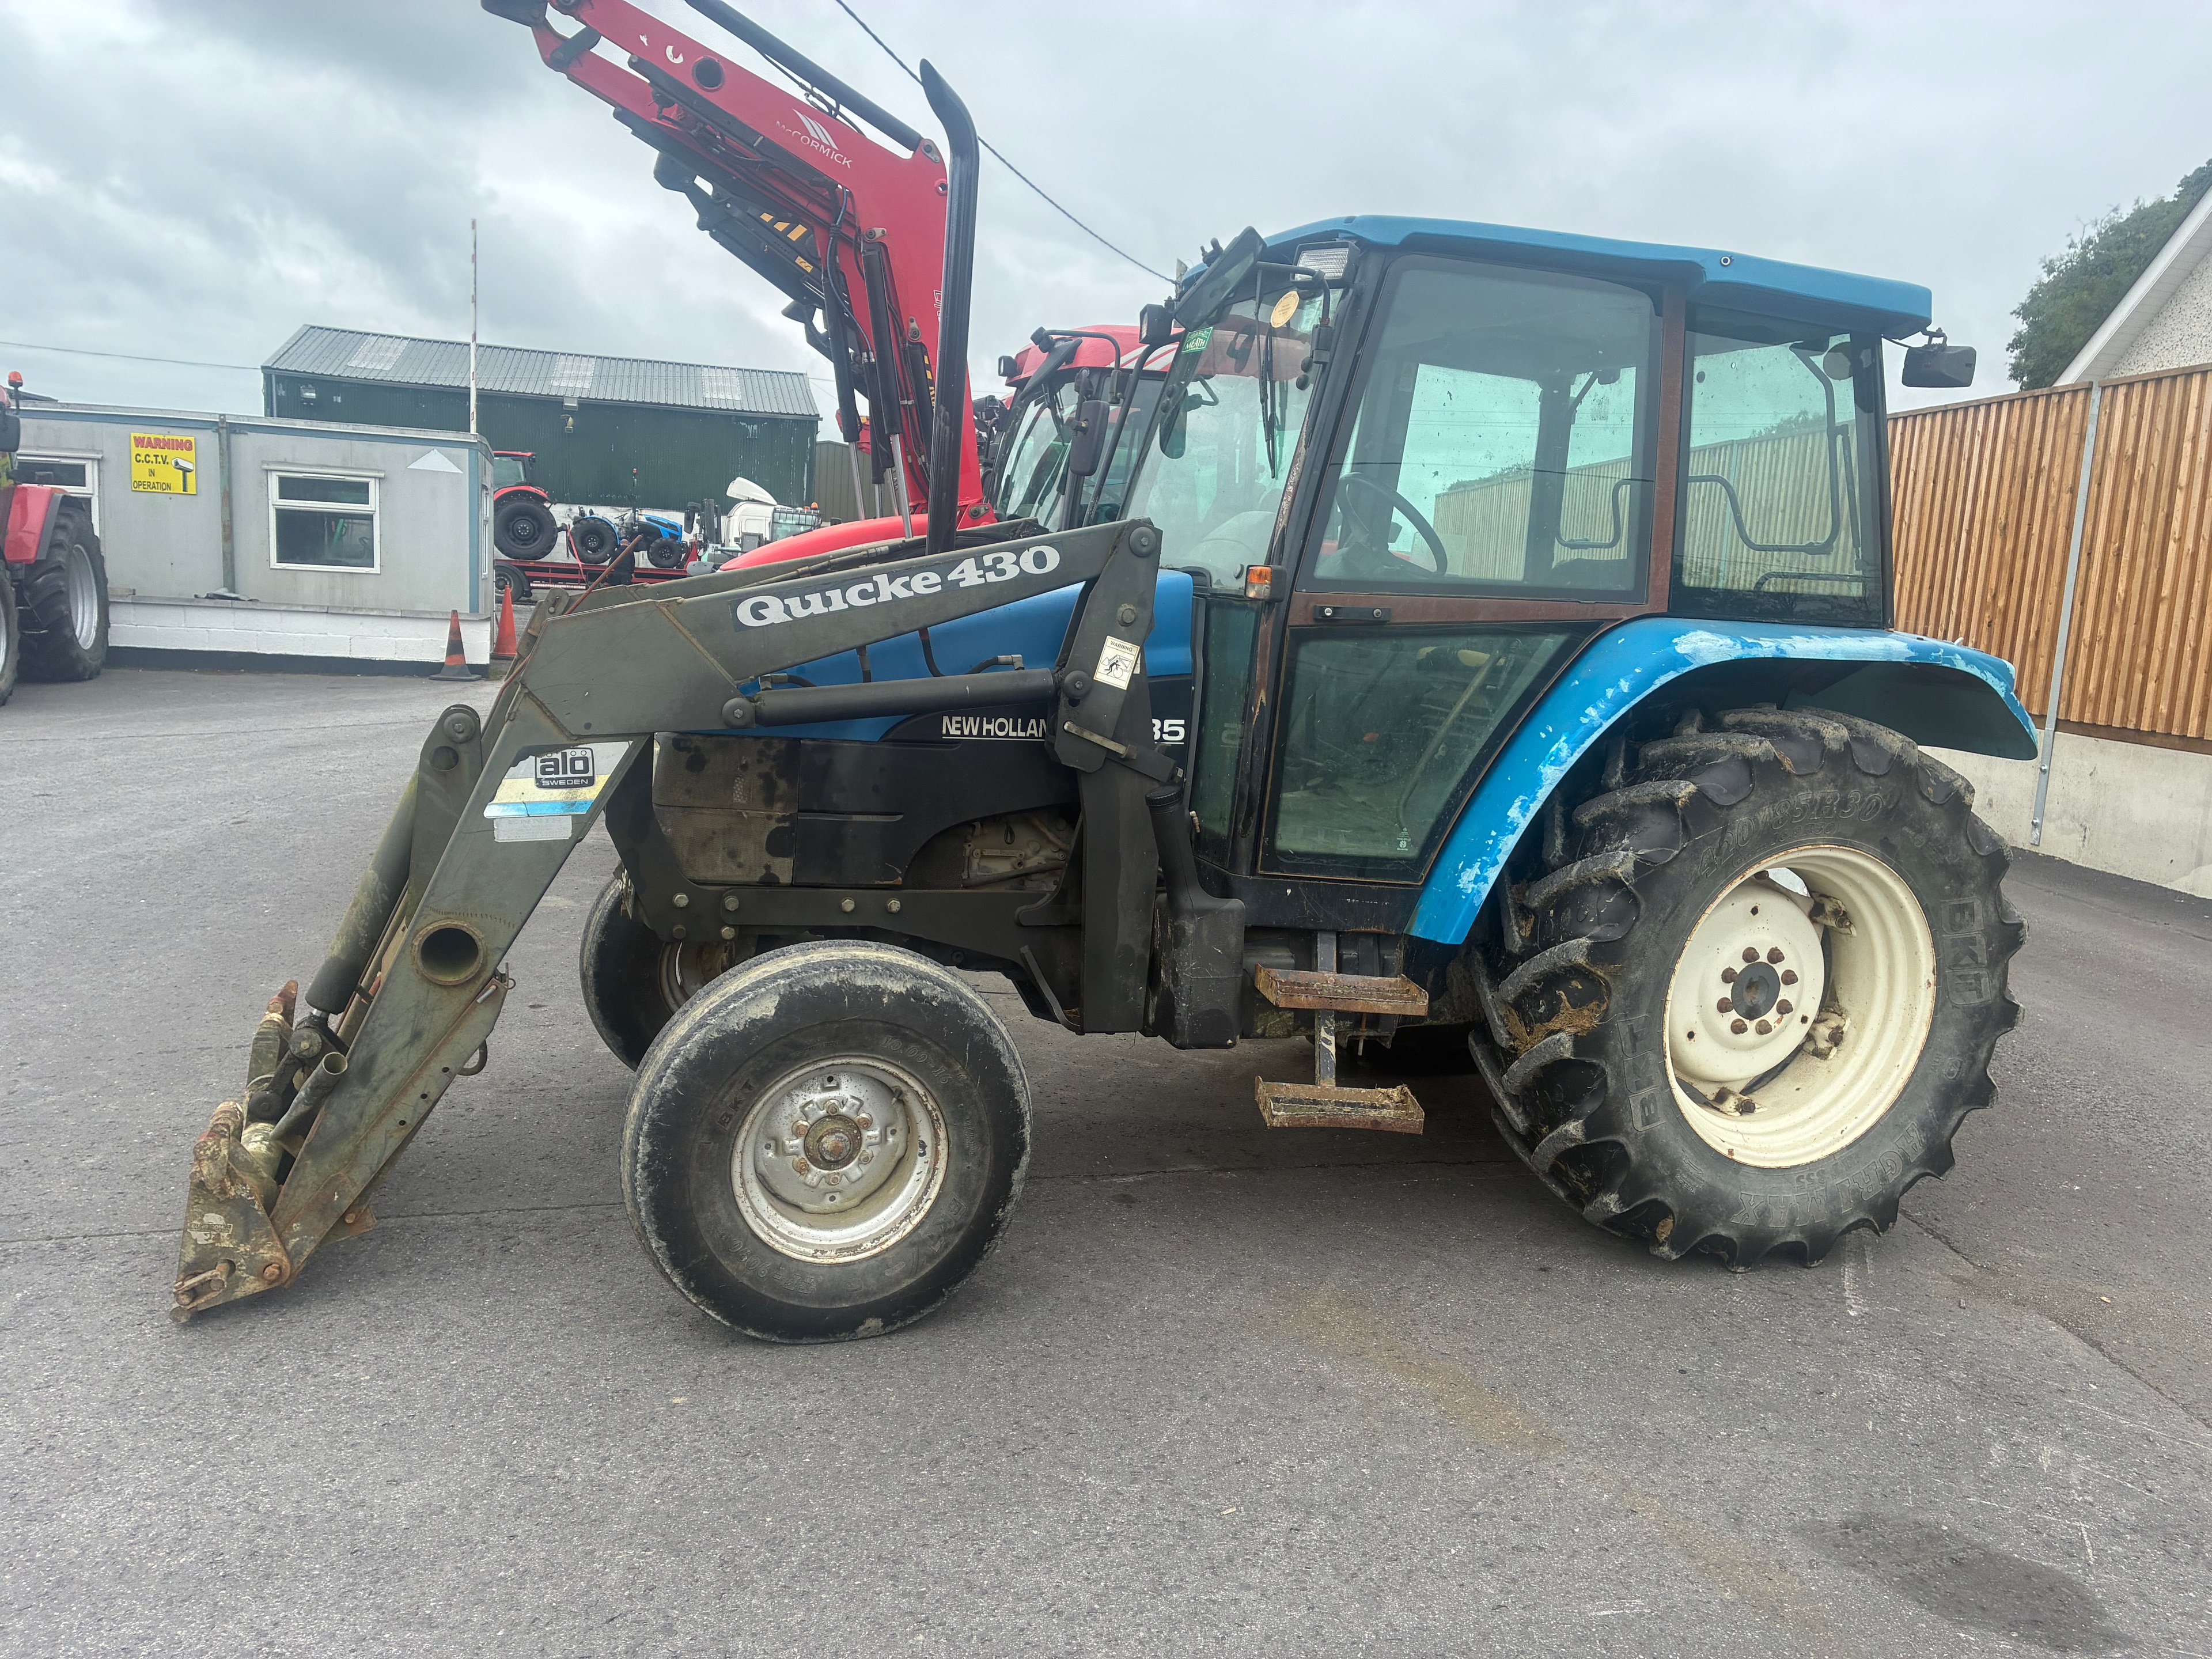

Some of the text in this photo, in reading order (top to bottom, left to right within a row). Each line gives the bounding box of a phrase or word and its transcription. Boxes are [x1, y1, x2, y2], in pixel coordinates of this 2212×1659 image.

[1184, 338, 1206, 350] MEATH
[133, 436, 193, 451] WARNING
[135, 453, 169, 465] C.C.T.V.
[148, 468, 155, 477] IN
[133, 480, 171, 491] OPERATION
[736, 546, 1060, 627] Quicke 430
[1111, 641, 1132, 653] WARNING
[942, 715, 1047, 737] NEW HOLLAN
[1945, 899, 1988, 1003] BKT
[881, 1035, 952, 1085] 10.00-16
[718, 1078, 755, 1128] BKT
